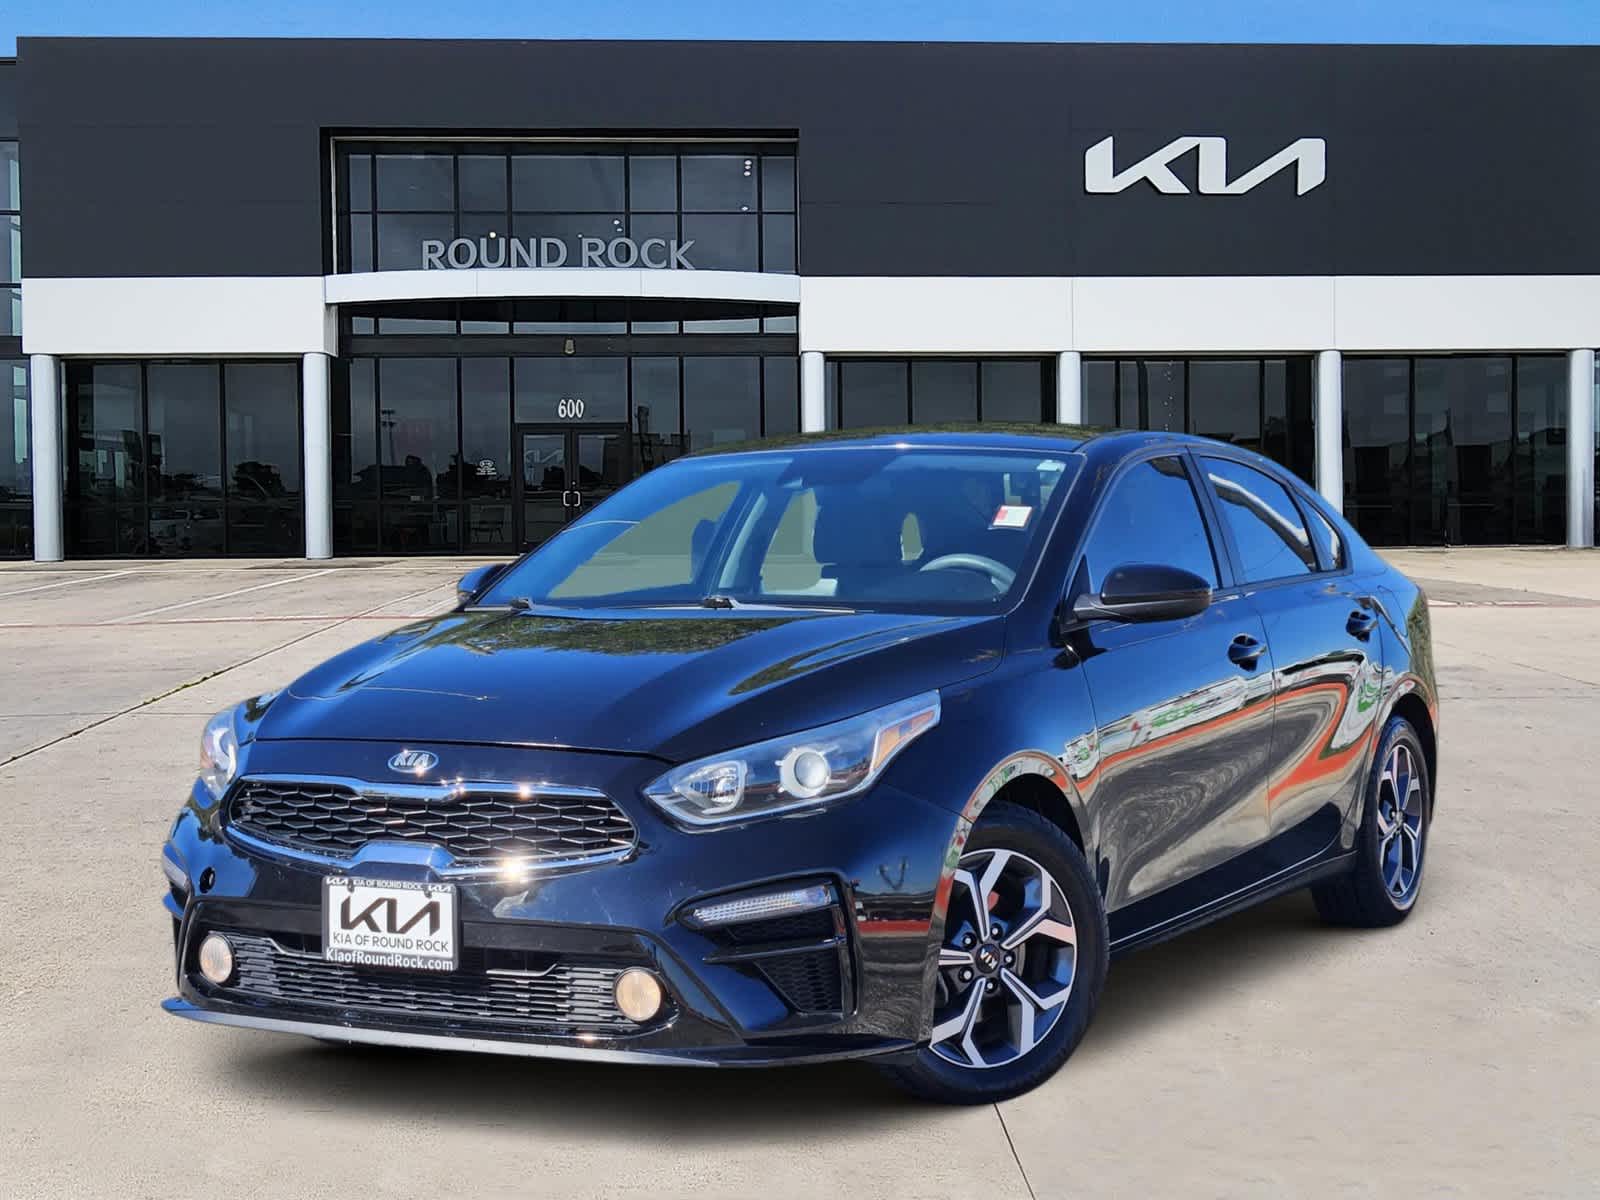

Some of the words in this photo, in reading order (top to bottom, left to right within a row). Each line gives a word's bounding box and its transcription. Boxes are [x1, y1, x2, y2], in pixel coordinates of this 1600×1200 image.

[1085, 135, 1326, 196] KIA
[421, 237, 568, 270] ROUND
[581, 238, 696, 270] ROCK
[558, 399, 585, 419] 600
[393, 752, 430, 768] KIA
[366, 879, 376, 888] OF
[377, 880, 402, 889] ROUND
[402, 881, 424, 891] ROCK
[340, 895, 441, 937] KIA
[333, 932, 352, 945] KIA
[354, 934, 370, 946] OF
[372, 935, 414, 950] ROUND
[416, 939, 449, 953] ROCK
[326, 948, 454, 971] KiaofRoundRock.com
